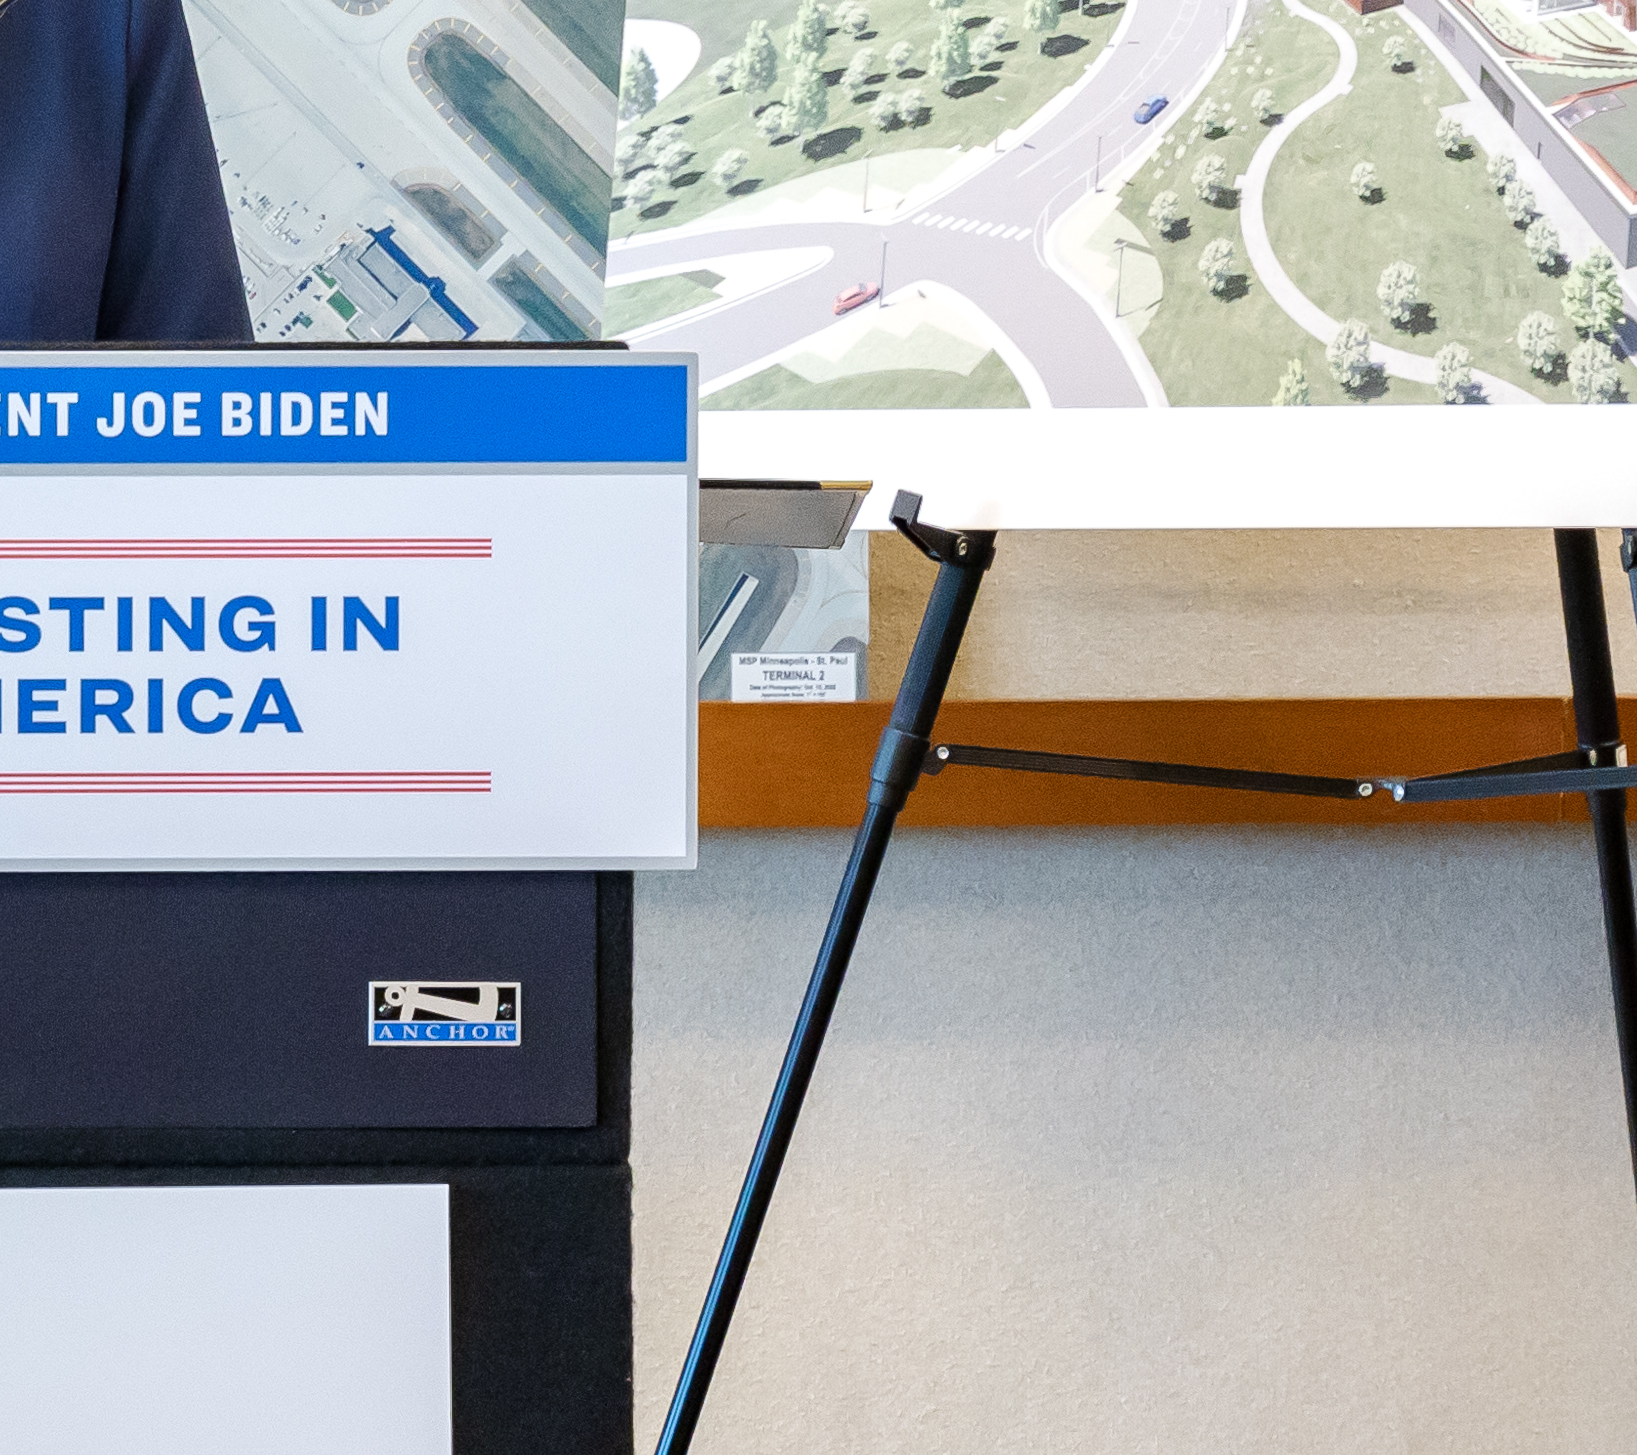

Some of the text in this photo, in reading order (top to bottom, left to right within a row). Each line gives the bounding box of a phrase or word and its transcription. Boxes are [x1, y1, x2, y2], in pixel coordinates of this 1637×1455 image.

[96, 391, 202, 438] JOE
[221, 391, 389, 437] BIDEN
[311, 595, 400, 652] IN
[763, 671, 824, 680] TERMINAL 2
